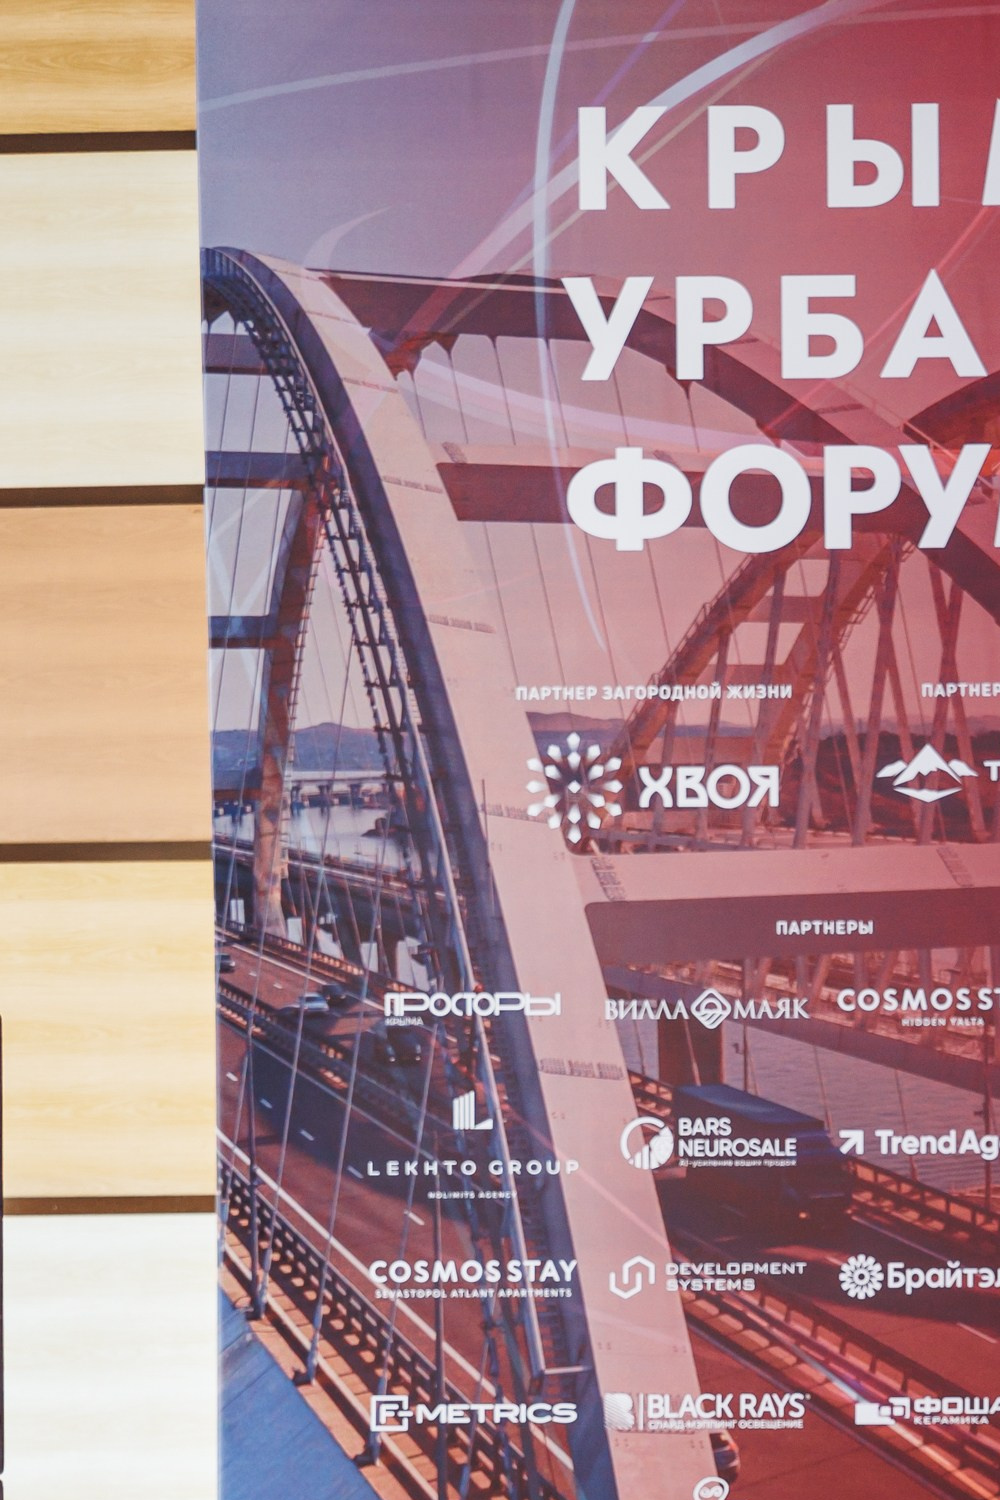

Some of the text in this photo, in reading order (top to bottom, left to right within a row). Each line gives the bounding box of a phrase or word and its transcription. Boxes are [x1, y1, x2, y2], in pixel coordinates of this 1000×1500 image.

[515, 681, 793, 702] ПАРТНЕР ЗАГОРОДНОЙ ЖИЗНИ
[638, 764, 780, 809] ХВОЯ
[775, 920, 874, 935] ПАРТНЕРЫ
[384, 992, 562, 1017] ПРОСТОРЫ
[604, 997, 810, 1020] ВИЛЛА МАЯК
[836, 988, 972, 1012] COSMOS
[902, 1016, 985, 1027] HIDDEN YALTA
[678, 1117, 731, 1136] BARS
[678, 1137, 798, 1157] NEUROSALE
[367, 1159, 580, 1176] LEKHTO GROUP
[368, 1260, 578, 1283] COSMOS STAY
[665, 1262, 807, 1275] DEVELOPMENT
[375, 1287, 573, 1299] SEVASTOPOL ATLANT APARTMENTS
[665, 1278, 756, 1291] SYSTEMS
[649, 1393, 806, 1418] BLACK RAYS
[913, 1415, 989, 1425] КЕРАМИКА
